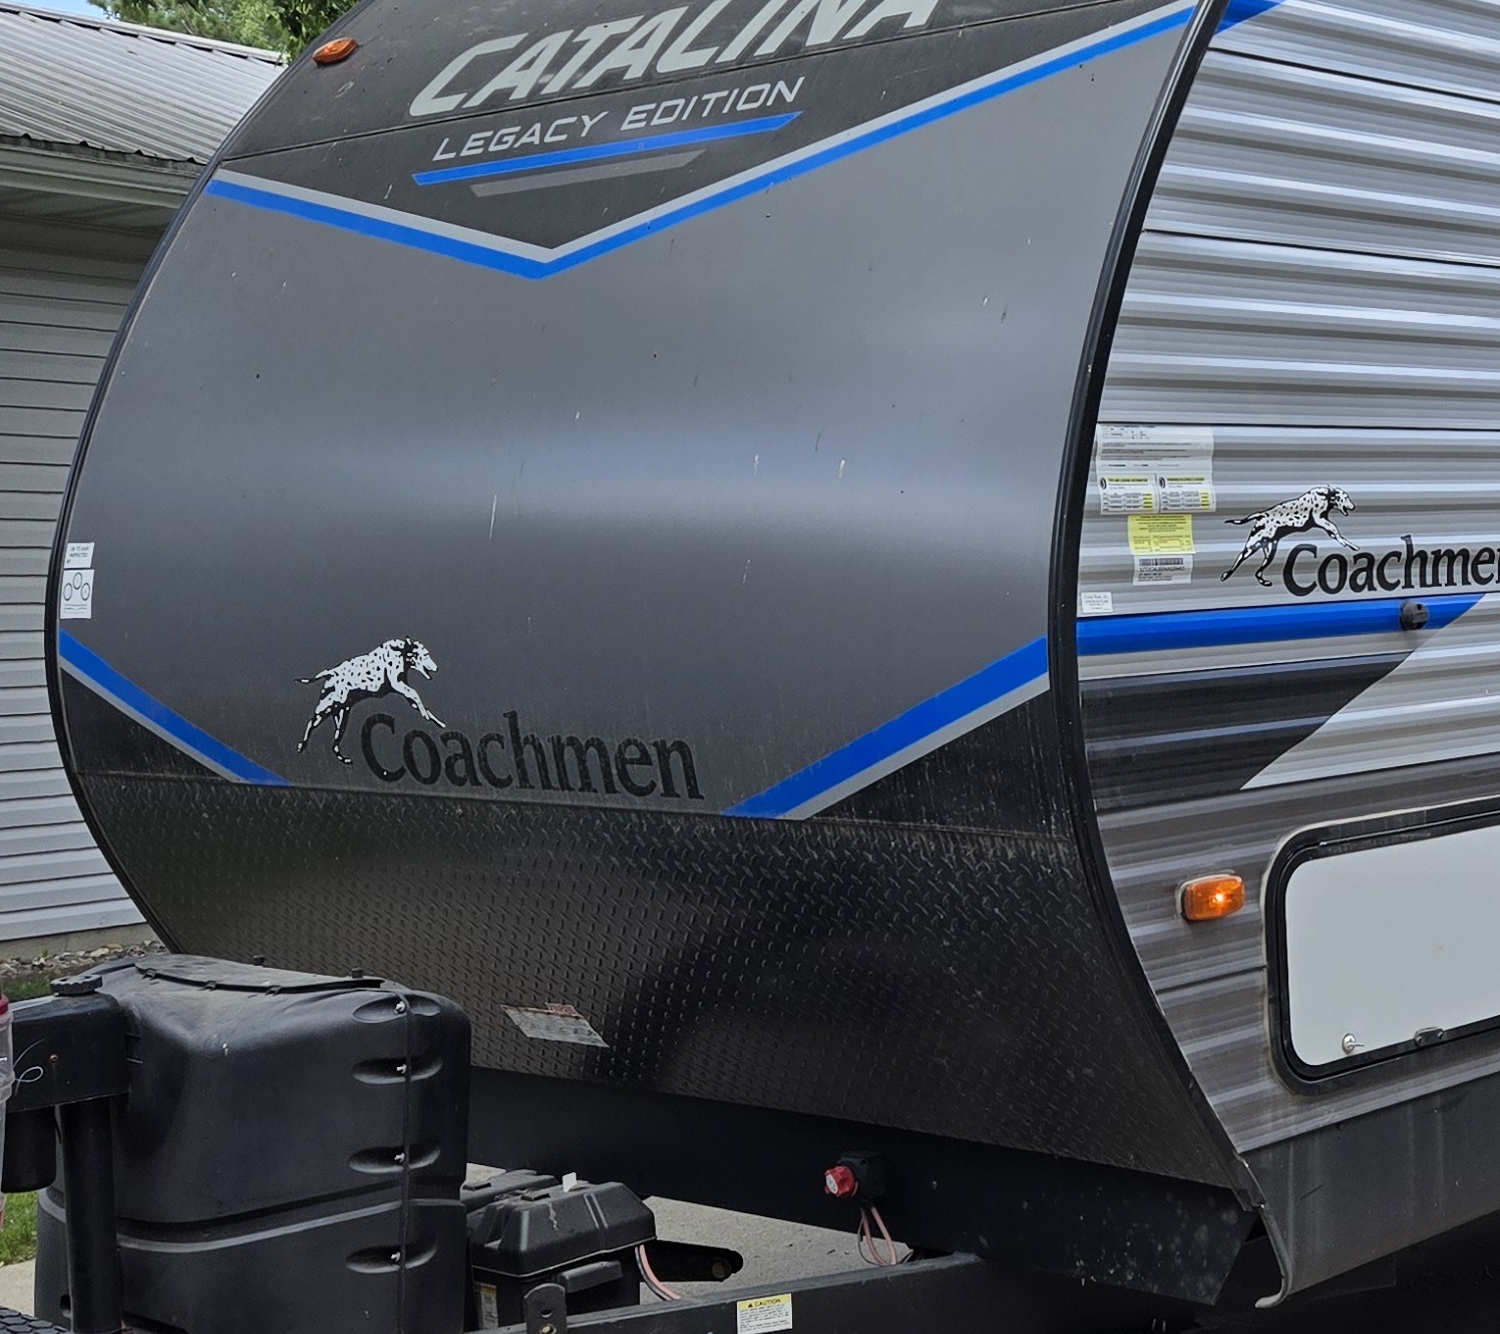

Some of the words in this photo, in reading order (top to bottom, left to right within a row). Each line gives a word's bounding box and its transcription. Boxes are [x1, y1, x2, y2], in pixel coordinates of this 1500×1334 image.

[432, 110, 609, 161] LEGACY
[621, 76, 805, 131] EDITION
[360, 710, 705, 801] Coachmen
[754, 1298, 781, 1307] CAUTION
